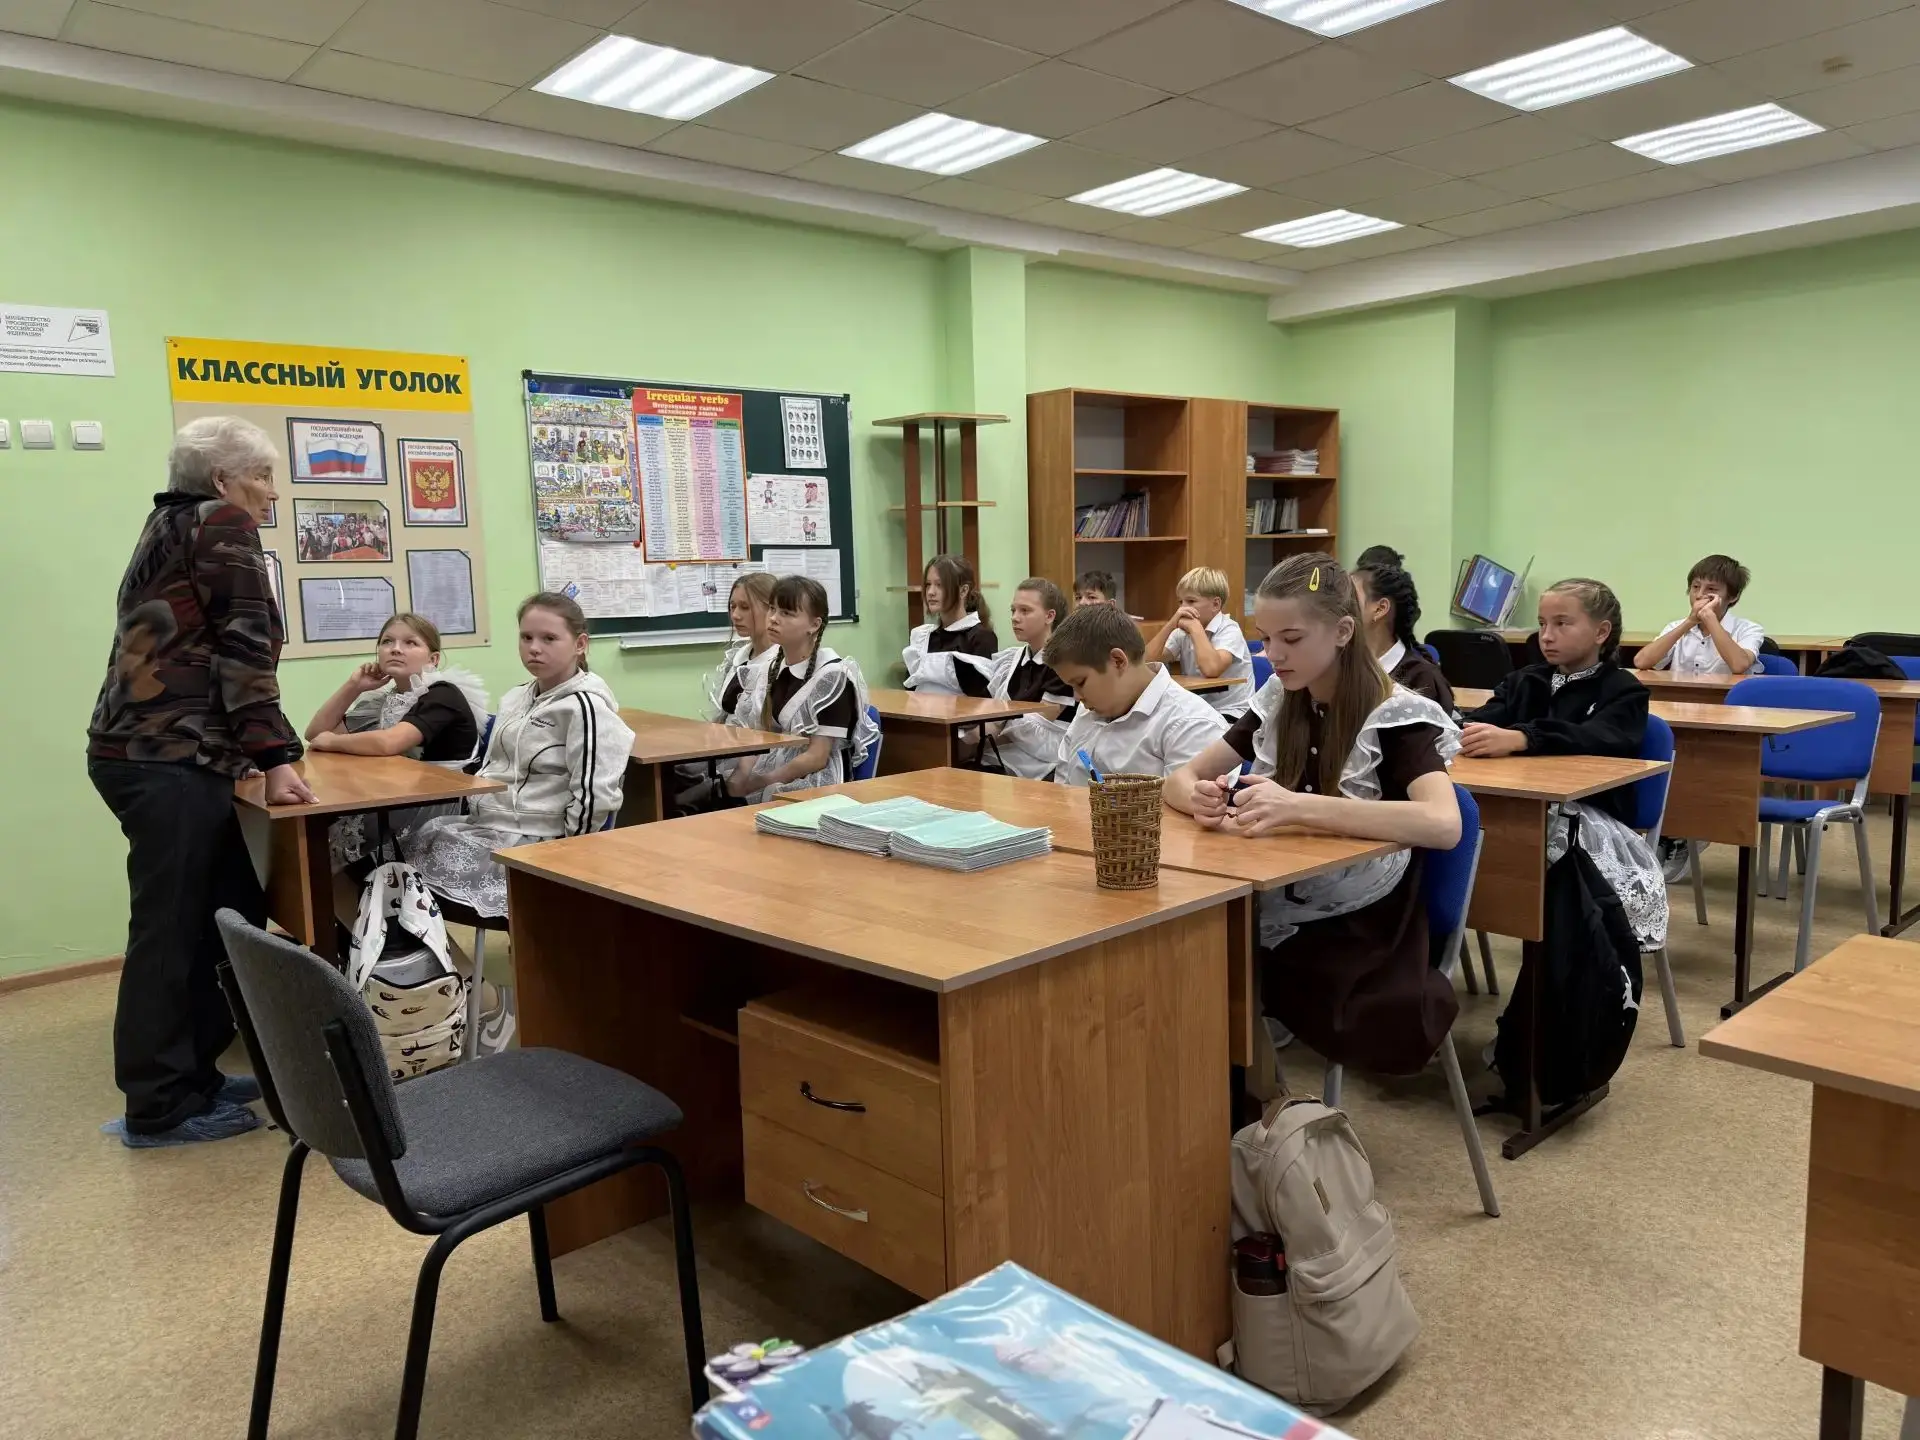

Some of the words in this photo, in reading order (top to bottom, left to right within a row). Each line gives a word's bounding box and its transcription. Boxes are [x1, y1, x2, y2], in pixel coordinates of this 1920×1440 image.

[177, 357, 345, 389] КЛАССНЫЙ
[356, 368, 462, 394] УГОЛОК
[646, 391, 697, 404] Irregular
[700, 395, 729, 405] verbs
